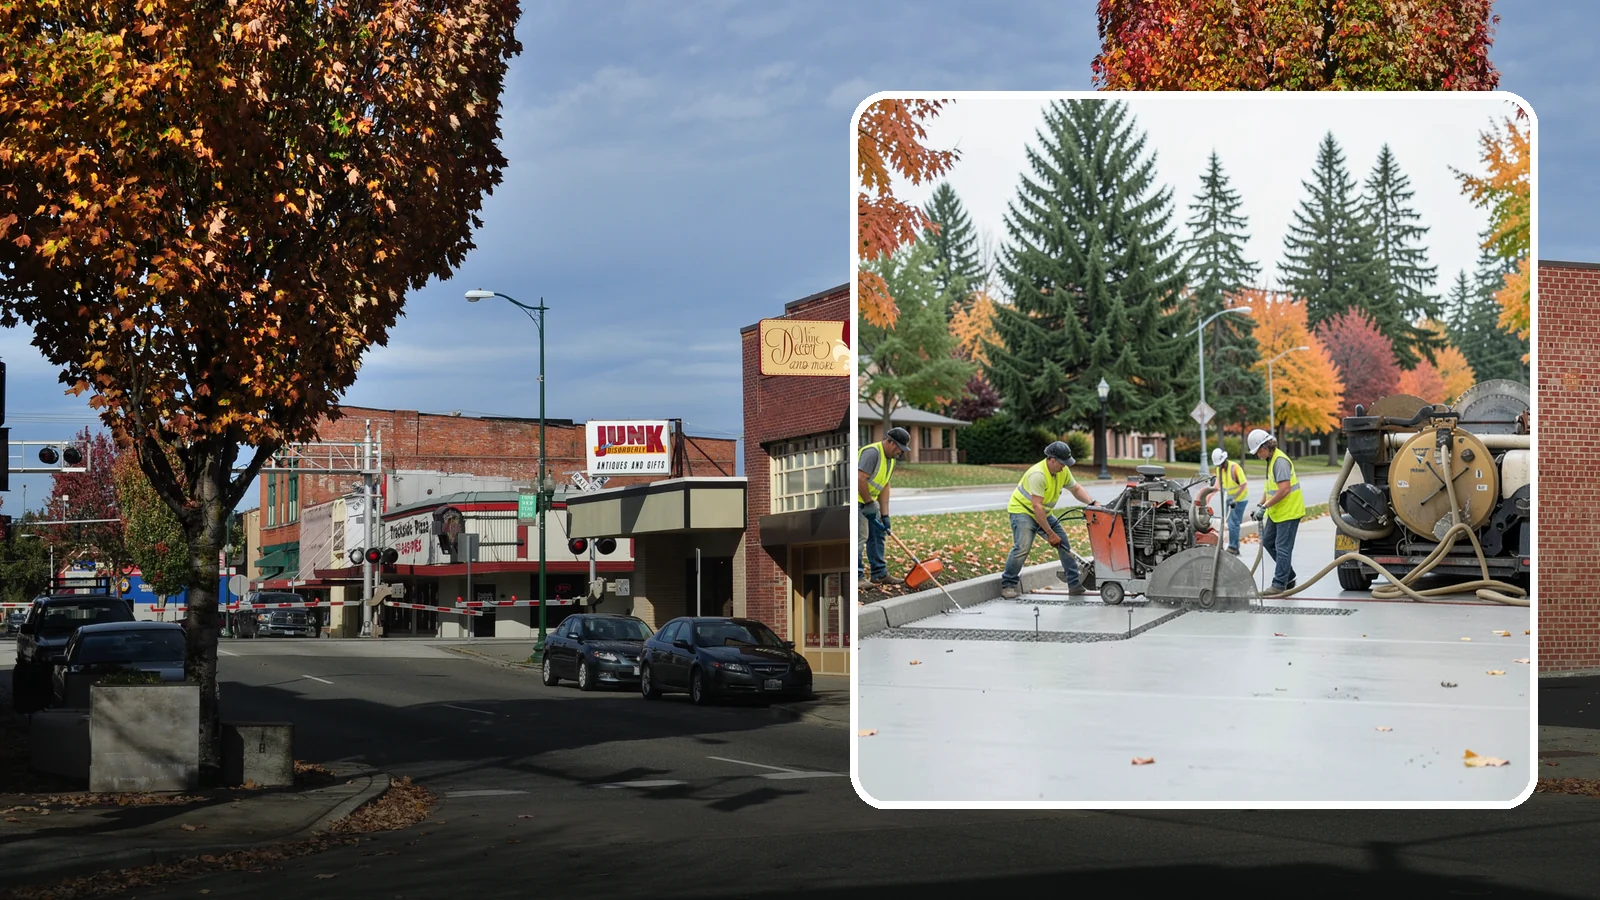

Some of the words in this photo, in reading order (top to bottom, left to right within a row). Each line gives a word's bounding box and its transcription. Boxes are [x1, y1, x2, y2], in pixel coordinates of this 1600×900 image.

[596, 425, 665, 457] JUNK
[607, 446, 645, 454] DISORDERLY
[597, 461, 628, 470] ANTIQUES
[631, 461, 644, 470] AND
[647, 461, 665, 470] GIFTS
[414, 519, 429, 535] Pizza
